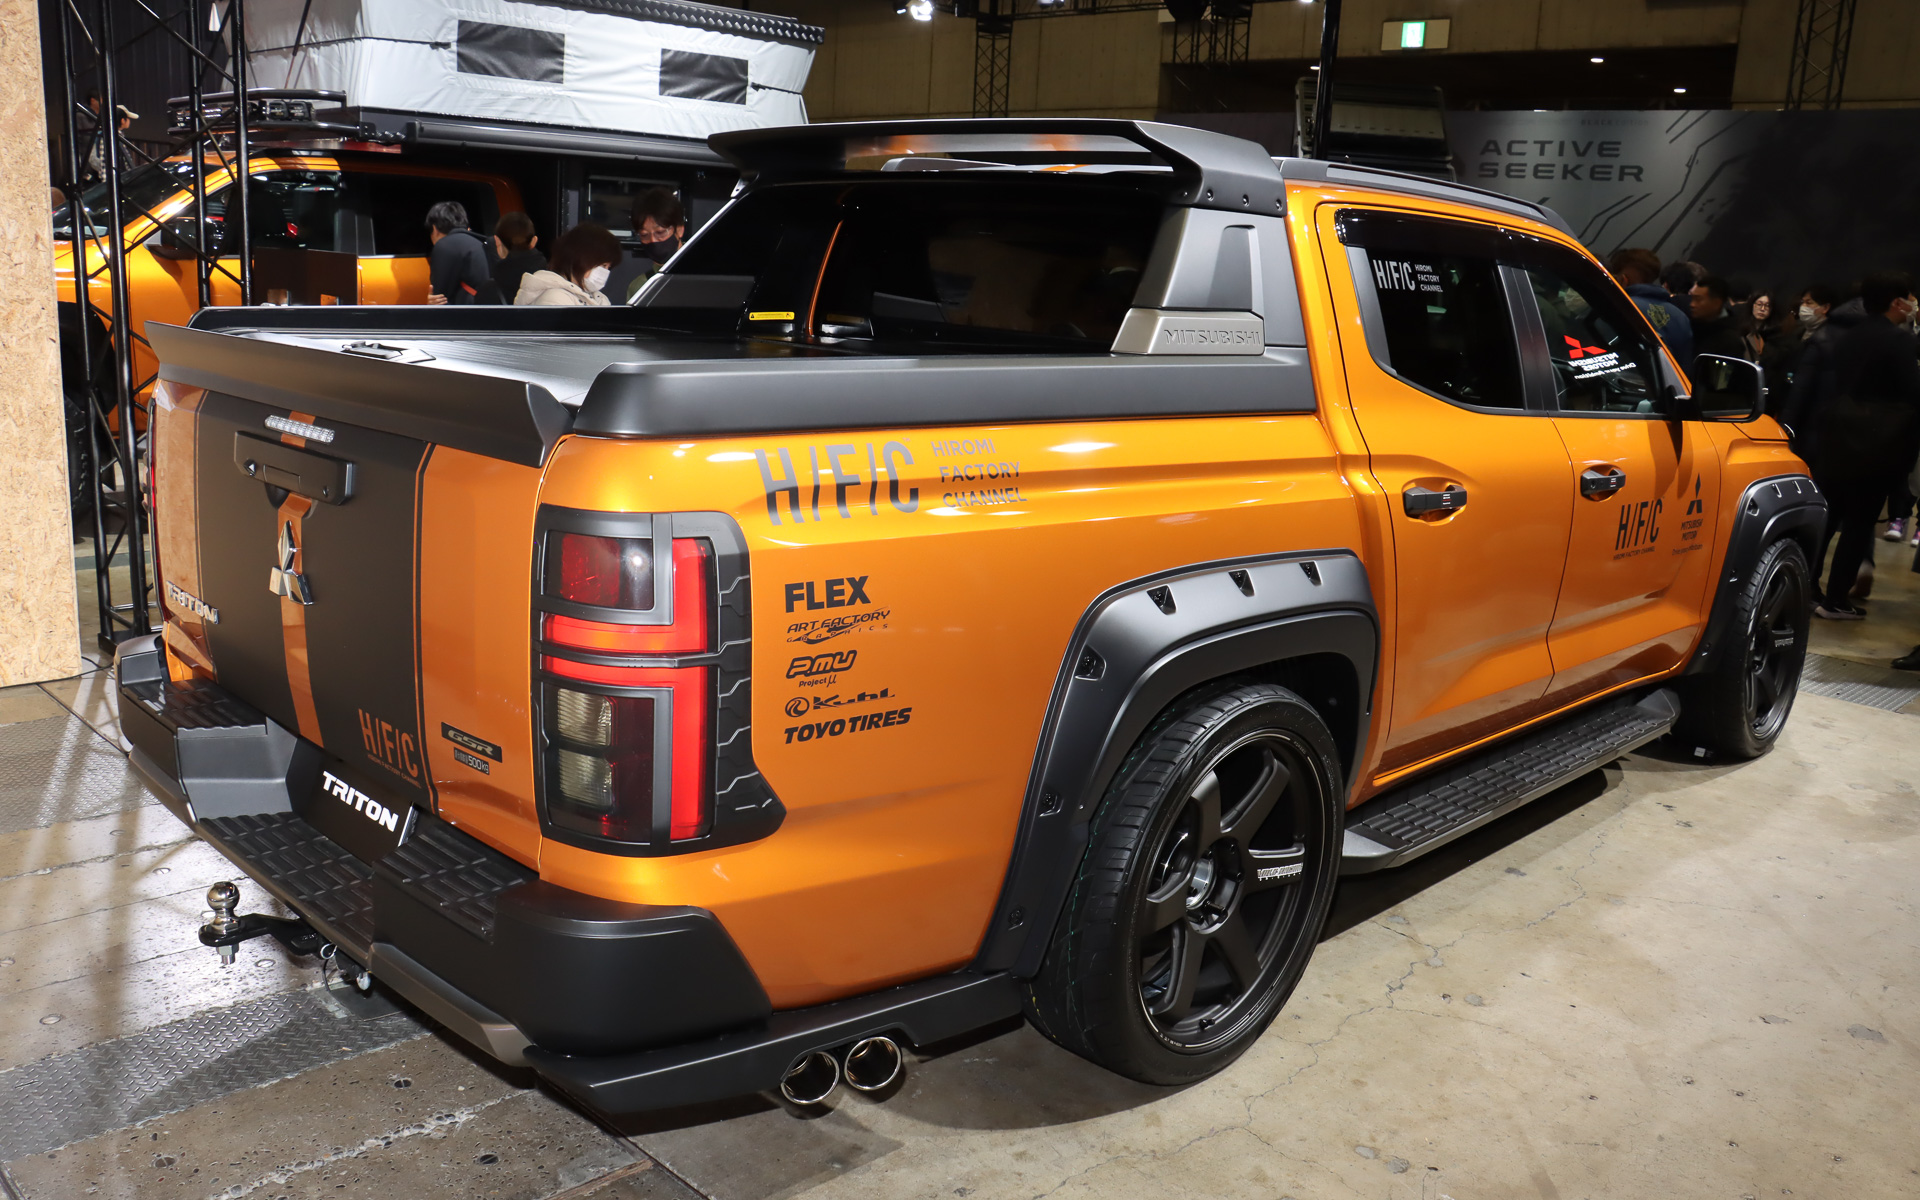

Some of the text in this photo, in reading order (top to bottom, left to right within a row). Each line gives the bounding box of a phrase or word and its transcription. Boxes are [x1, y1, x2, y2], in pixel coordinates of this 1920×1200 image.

[1480, 139, 1622, 158] ACTIVE
[1478, 162, 1644, 182] SEEKER
[1417, 273, 1440, 283] FACTORY
[1420, 284, 1443, 293] CHANNEL
[1164, 329, 1260, 345] MITSUBISHI
[930, 438, 996, 457] HIROMI
[939, 461, 1020, 483] FACTORY
[754, 440, 919, 527] H/F/C
[943, 487, 1028, 508] CHANNEL
[166, 580, 219, 624] TRITON
[785, 575, 871, 613] FLEX
[787, 609, 891, 634] ART FACTORY
[799, 677, 827, 688] Project
[784, 707, 912, 744] TOYO TIRES
[448, 730, 493, 755] GSR
[323, 771, 399, 832] TRITON
